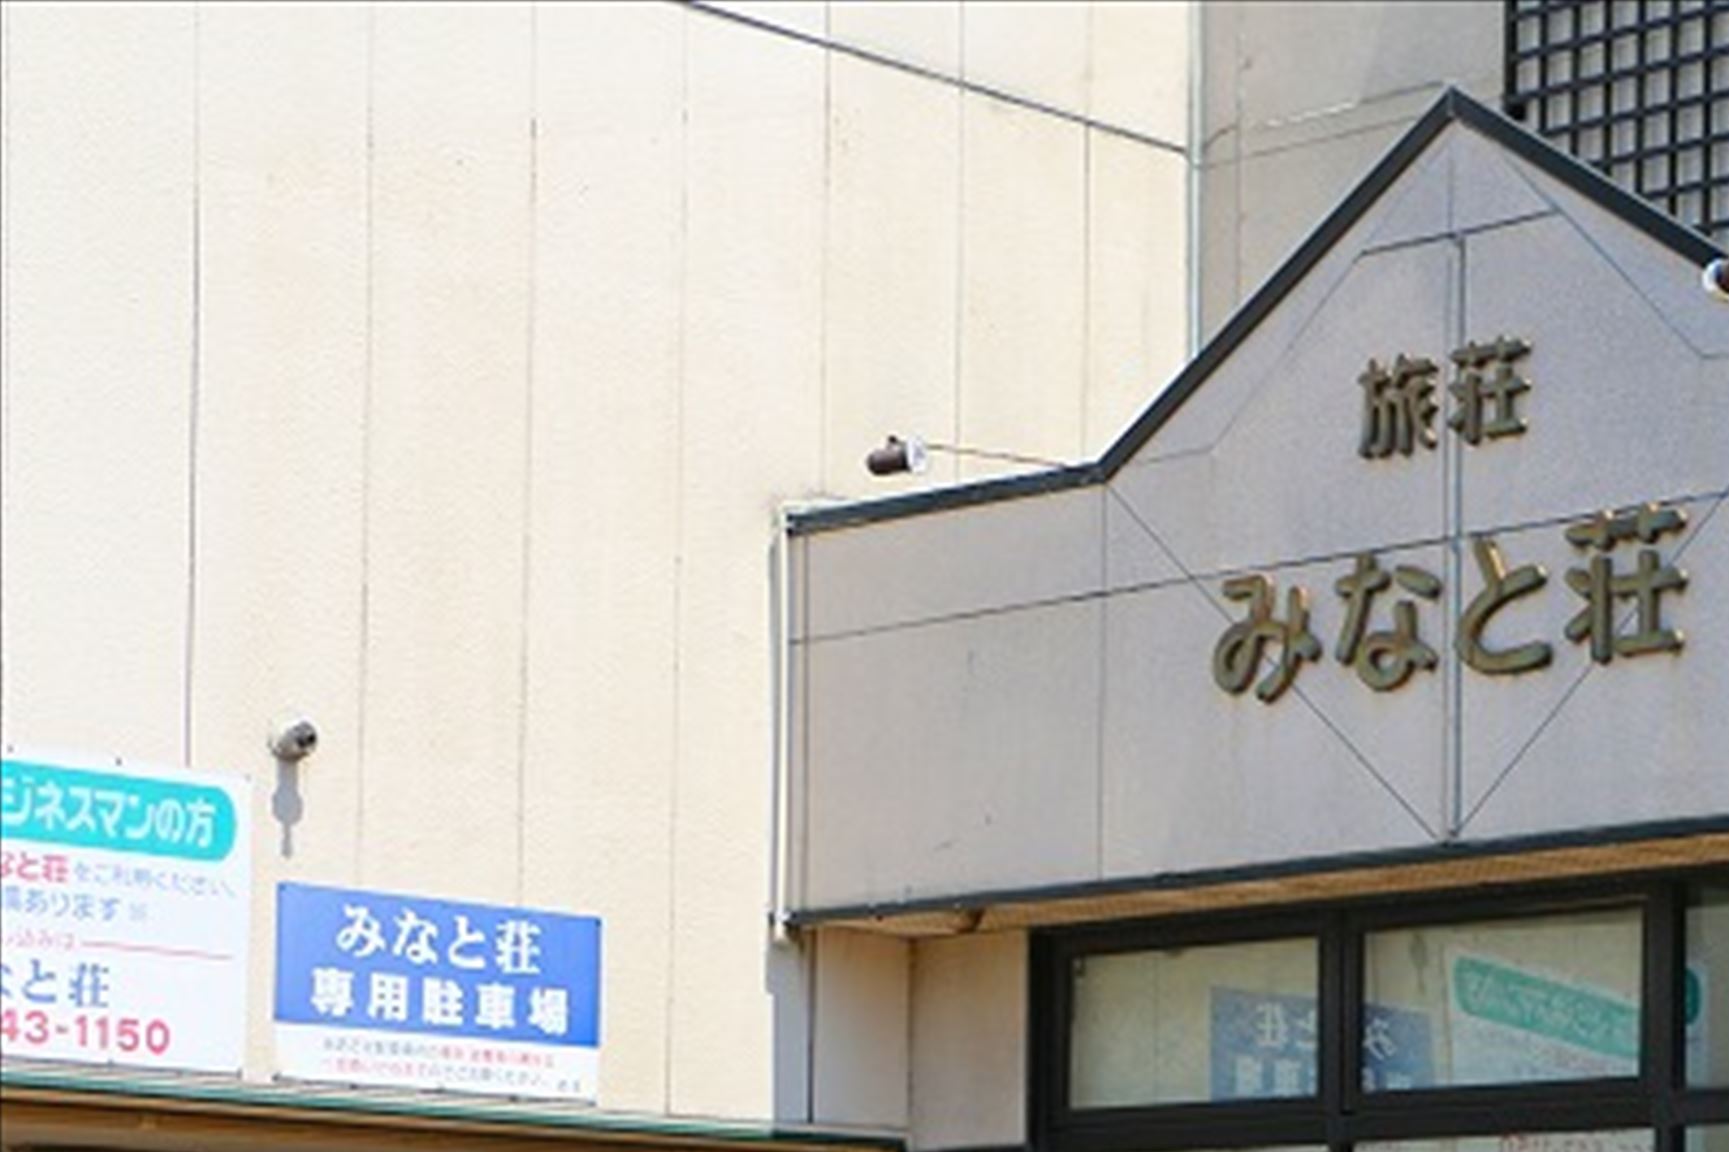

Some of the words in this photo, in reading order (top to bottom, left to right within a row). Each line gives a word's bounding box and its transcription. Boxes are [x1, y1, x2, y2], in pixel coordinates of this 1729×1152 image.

[1357, 335, 1533, 459] 旅荘
[1213, 504, 1690, 702] みなと荘
[336, 904, 542, 974] みなと荘
[1, 957, 110, 1008] と荘
[311, 965, 569, 1036] 専用駐車場
[1, 1008, 171, 1055] 43-1150
